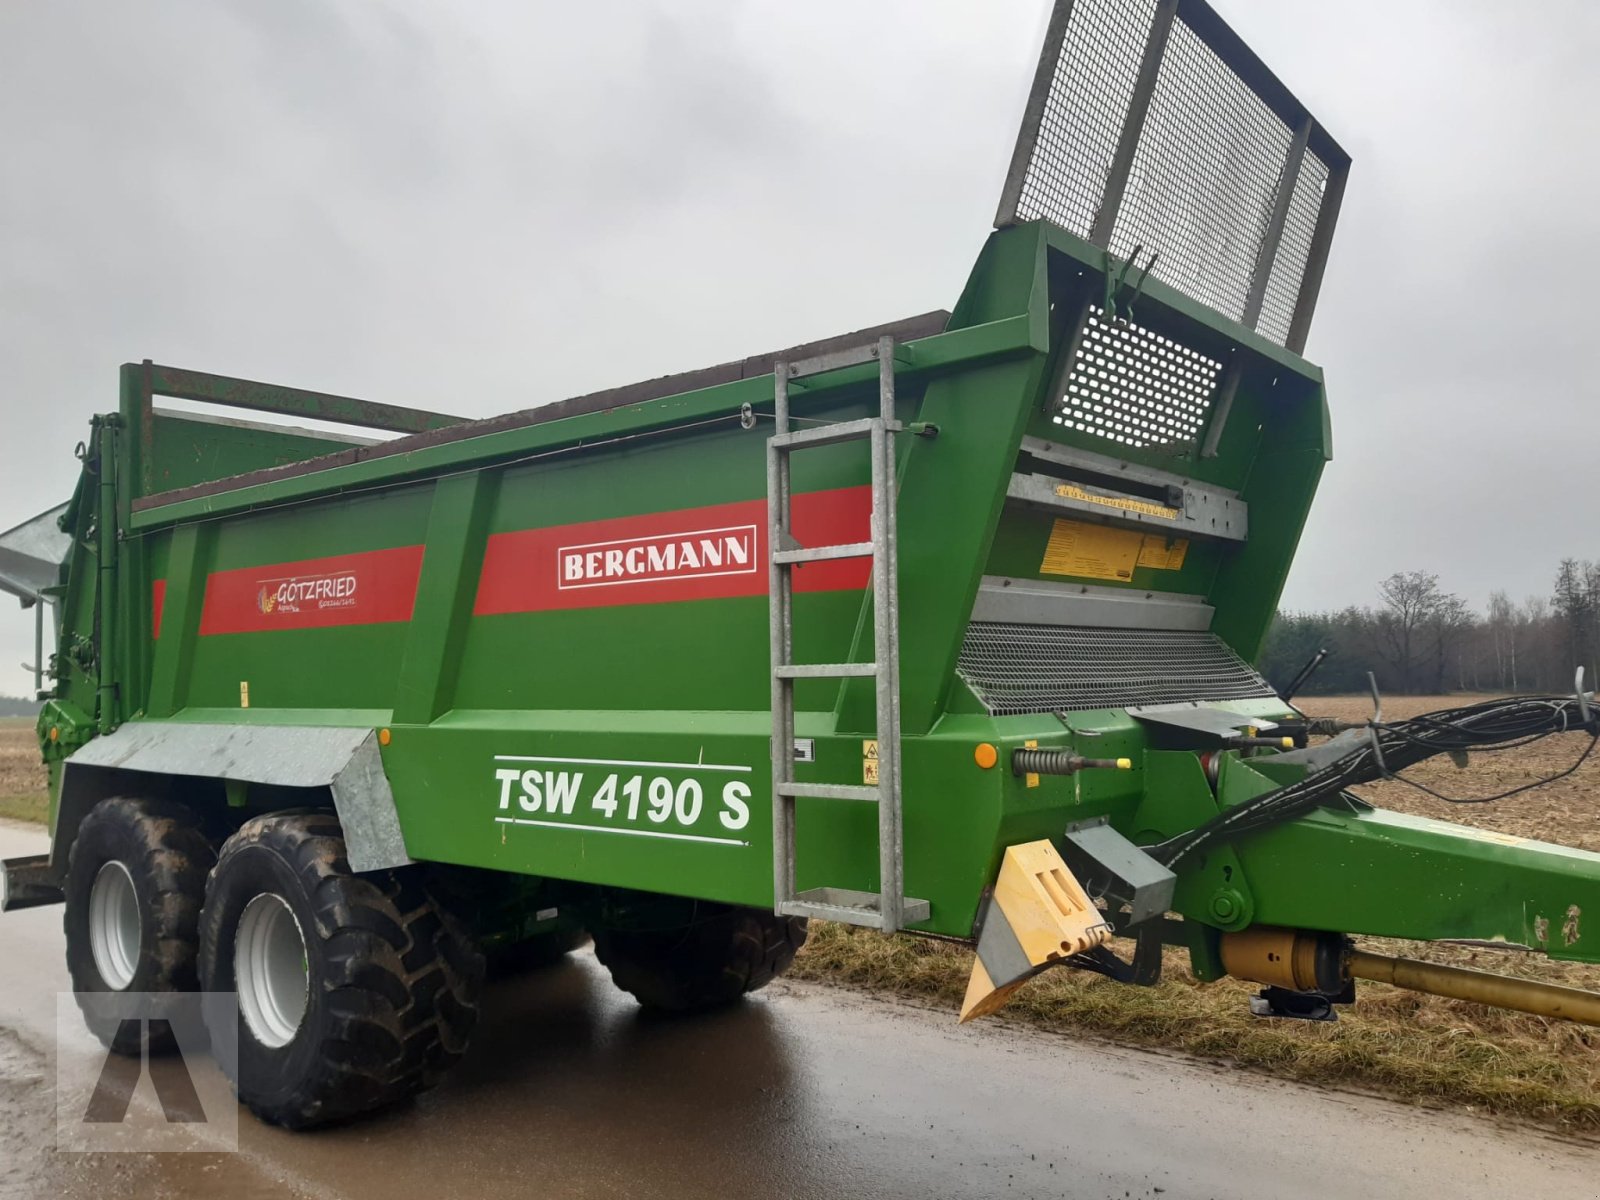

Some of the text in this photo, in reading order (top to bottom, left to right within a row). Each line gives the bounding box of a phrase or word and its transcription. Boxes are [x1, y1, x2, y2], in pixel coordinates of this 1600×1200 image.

[565, 536, 748, 580] BERGMANN
[277, 577, 356, 603] GÖTZFRIED
[495, 768, 752, 830] TSW 4190 S
